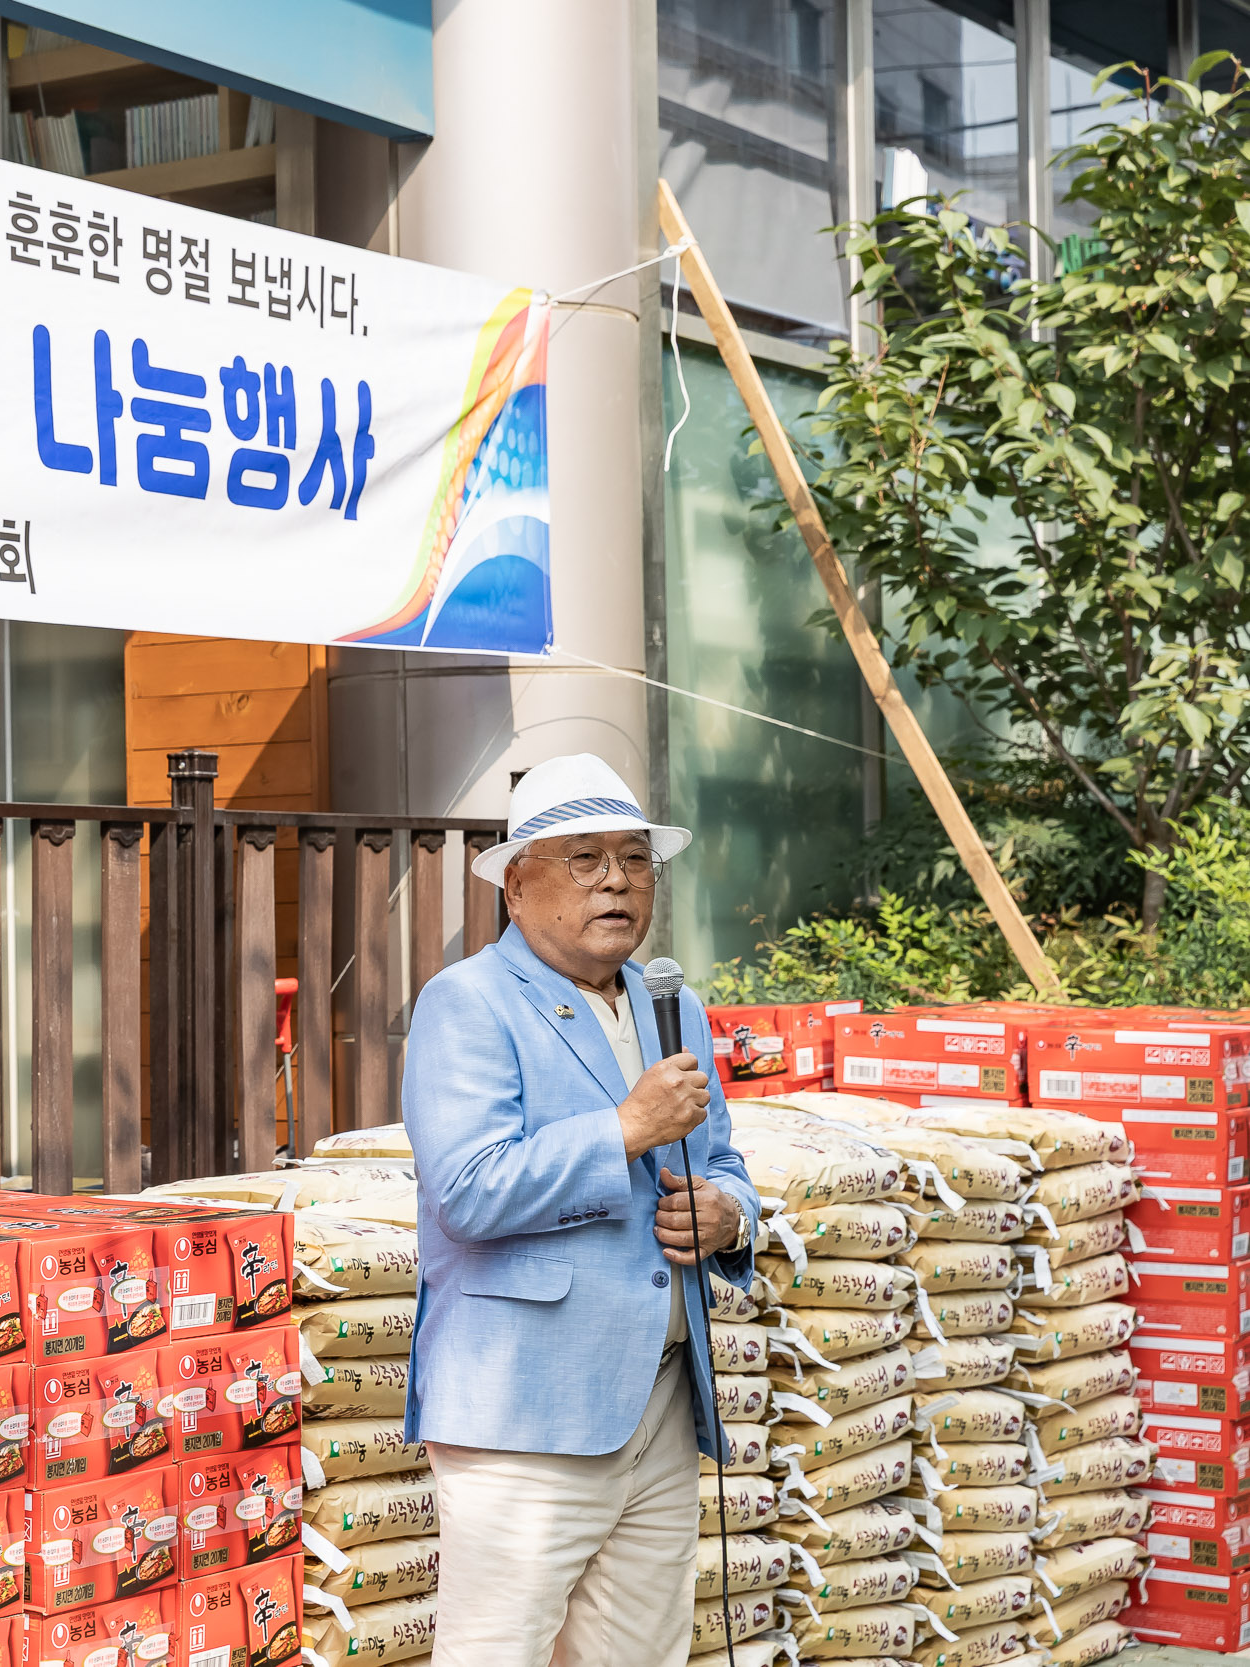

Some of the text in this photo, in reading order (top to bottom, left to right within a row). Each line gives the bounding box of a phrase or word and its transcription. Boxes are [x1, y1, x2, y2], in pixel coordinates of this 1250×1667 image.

[4, 191, 123, 285] 훈훈한
[142, 226, 212, 305] 명절
[228, 247, 370, 338] 보냅시다.
[32, 324, 376, 521] 나눔행사
[192, 1238, 217, 1257] 농심
[59, 1256, 86, 1276] 농심
[217, 1297, 234, 1310] 봉지면
[216, 1310, 232, 1323] 20개입
[44, 1335, 86, 1356] 봉지면 20개입
[196, 1355, 223, 1374] 농심
[63, 1378, 91, 1398] 농심
[184, 1431, 223, 1452] 봉지면 20개입
[46, 1462, 66, 1480] 봉지면
[205, 1471, 230, 1491] 농심
[70, 1503, 98, 1525] 농심
[192, 1549, 229, 1569] 봉지면 20개입
[55, 1584, 94, 1606] 봉지면 20개입
[206, 1590, 231, 1611] 농심
[69, 1619, 96, 1642] 농심
